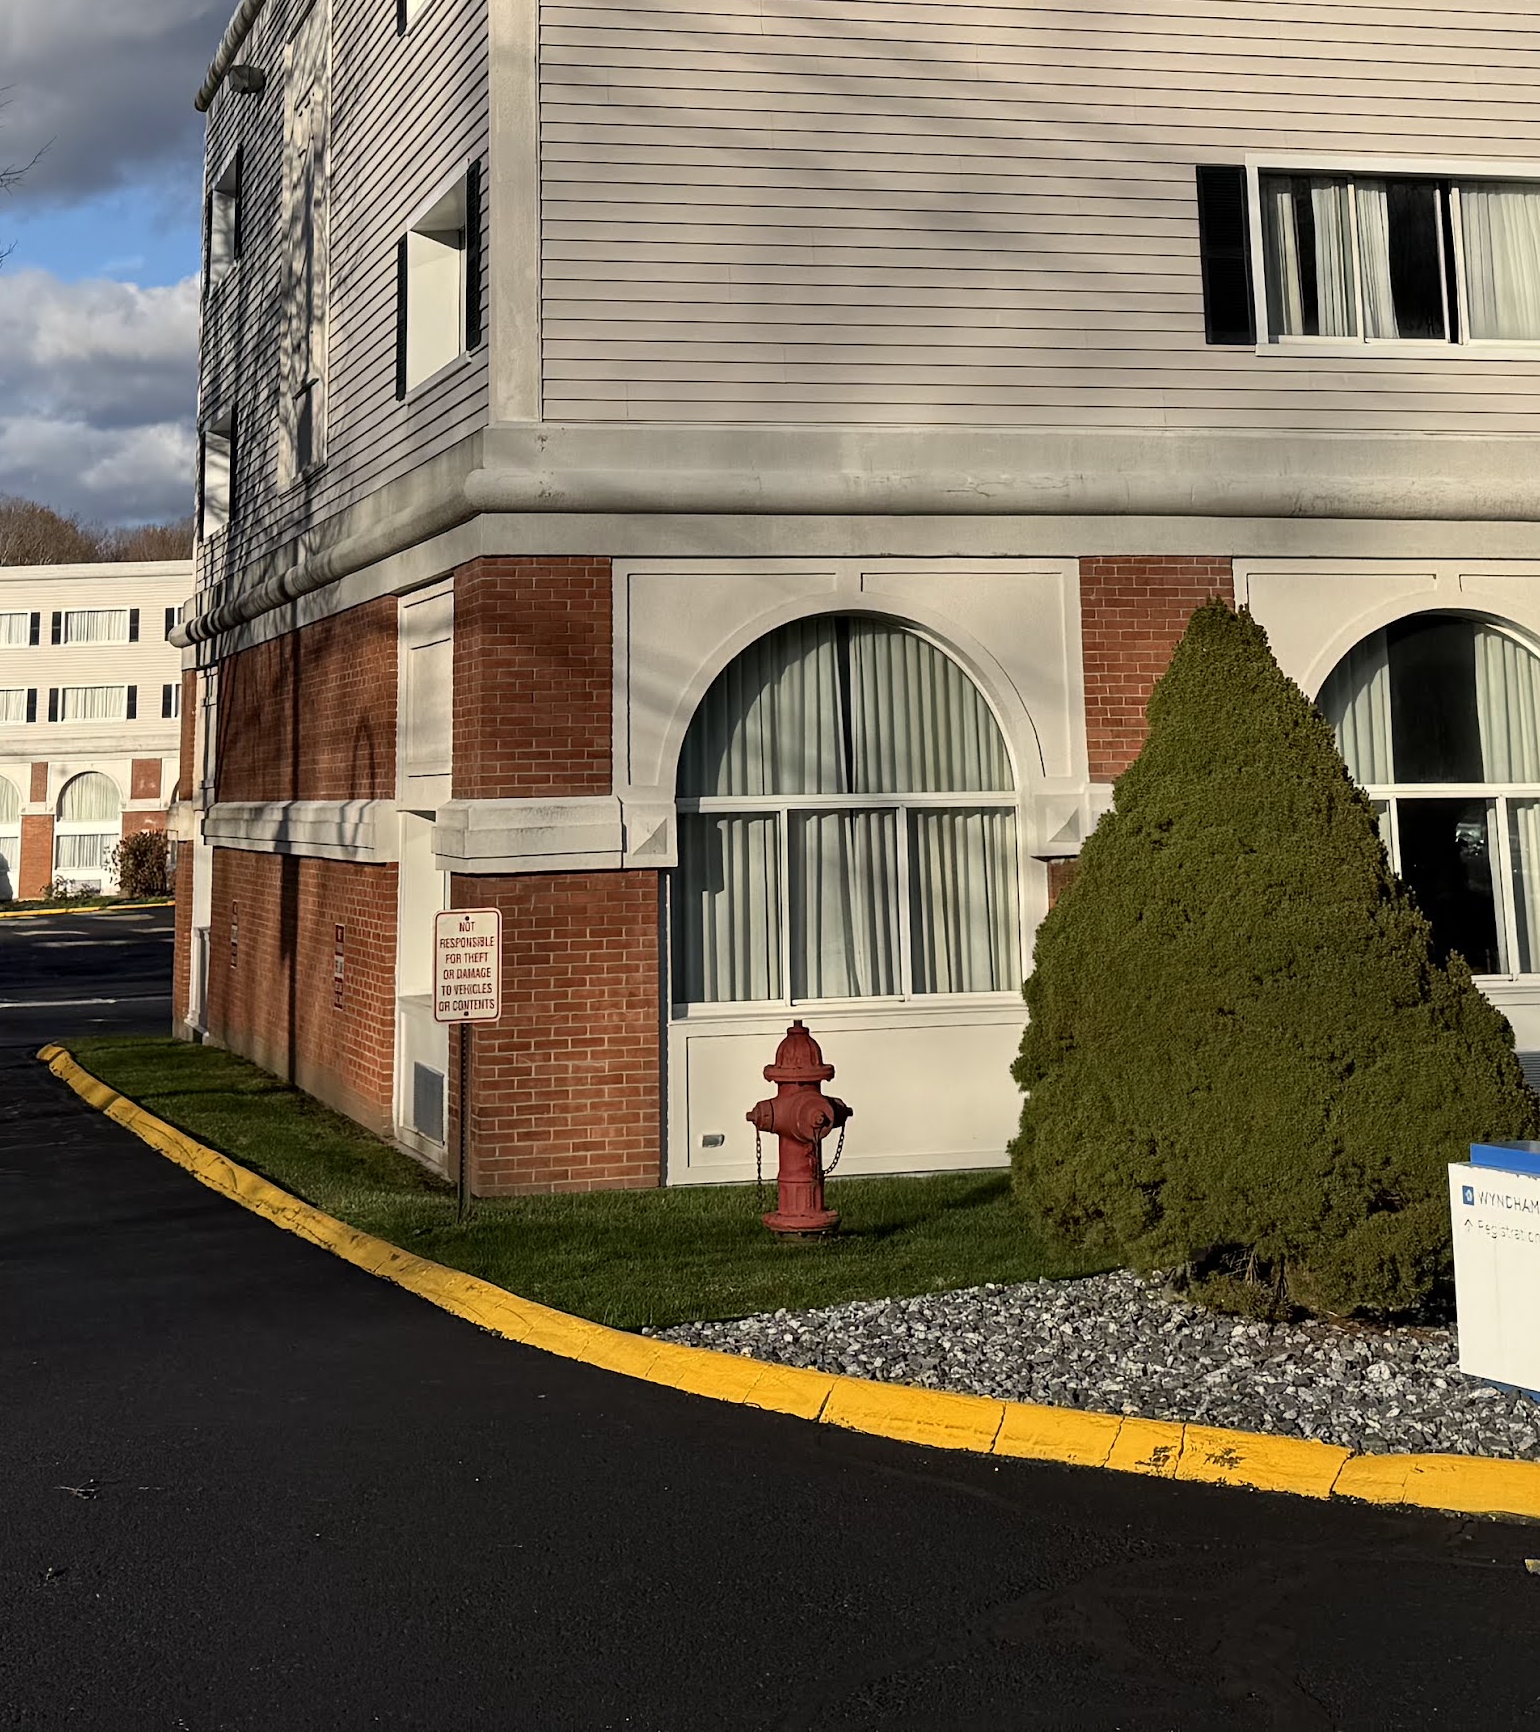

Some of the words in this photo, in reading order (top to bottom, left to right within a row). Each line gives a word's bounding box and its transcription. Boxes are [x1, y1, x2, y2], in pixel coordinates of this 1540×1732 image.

[459, 921, 475, 932] NOT
[440, 936, 495, 948] RESPONSIBLE
[445, 953, 462, 964] FOR
[464, 952, 489, 963] THEFT
[443, 969, 455, 980] OR
[457, 967, 491, 979] DAMAGE
[441, 985, 452, 996] TO
[454, 983, 493, 995] VEHICLES
[438, 1001, 451, 1012] OR
[453, 999, 495, 1011] CONTENTS
[1479, 1191, 1540, 1214] WYNDHAM
